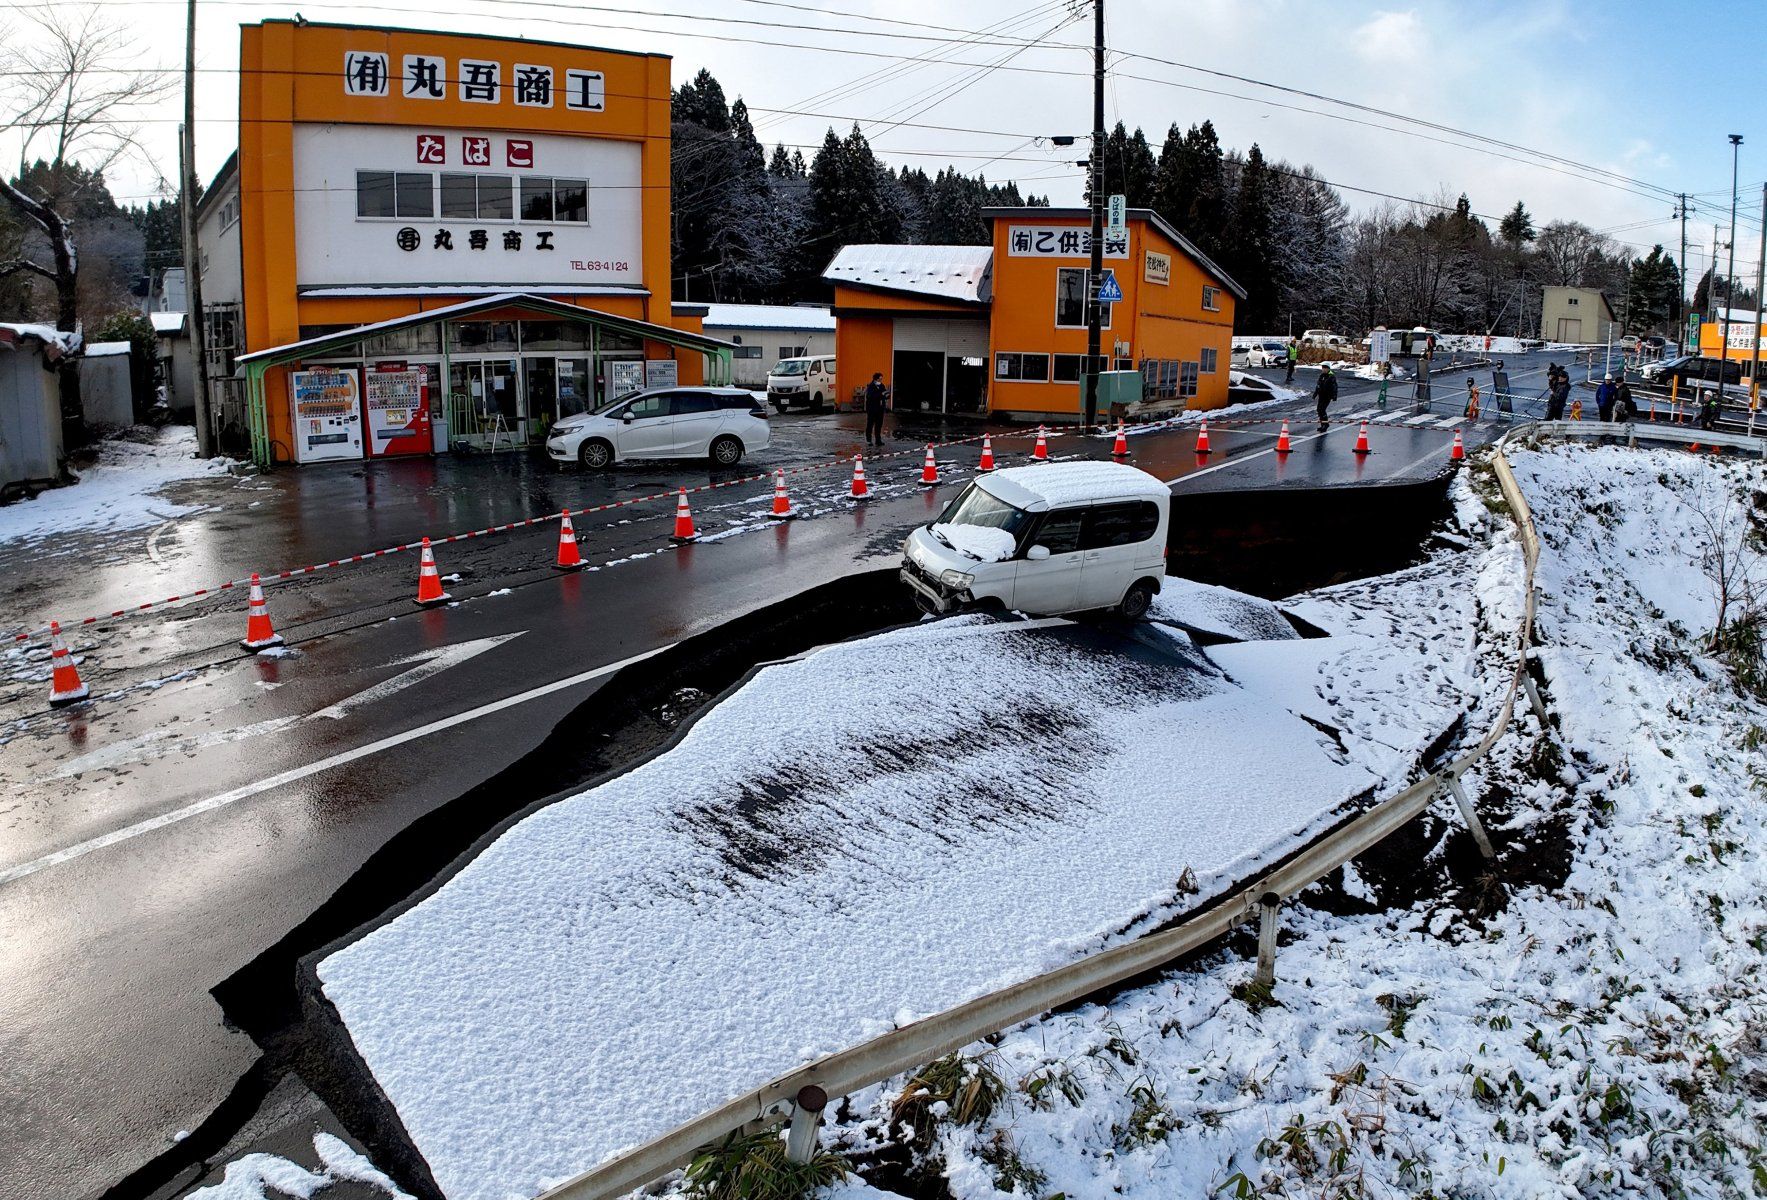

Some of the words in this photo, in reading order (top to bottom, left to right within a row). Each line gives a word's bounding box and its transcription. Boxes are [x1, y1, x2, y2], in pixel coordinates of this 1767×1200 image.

[419, 136, 531, 166] たばこ
[570, 260, 587, 271] TEL
